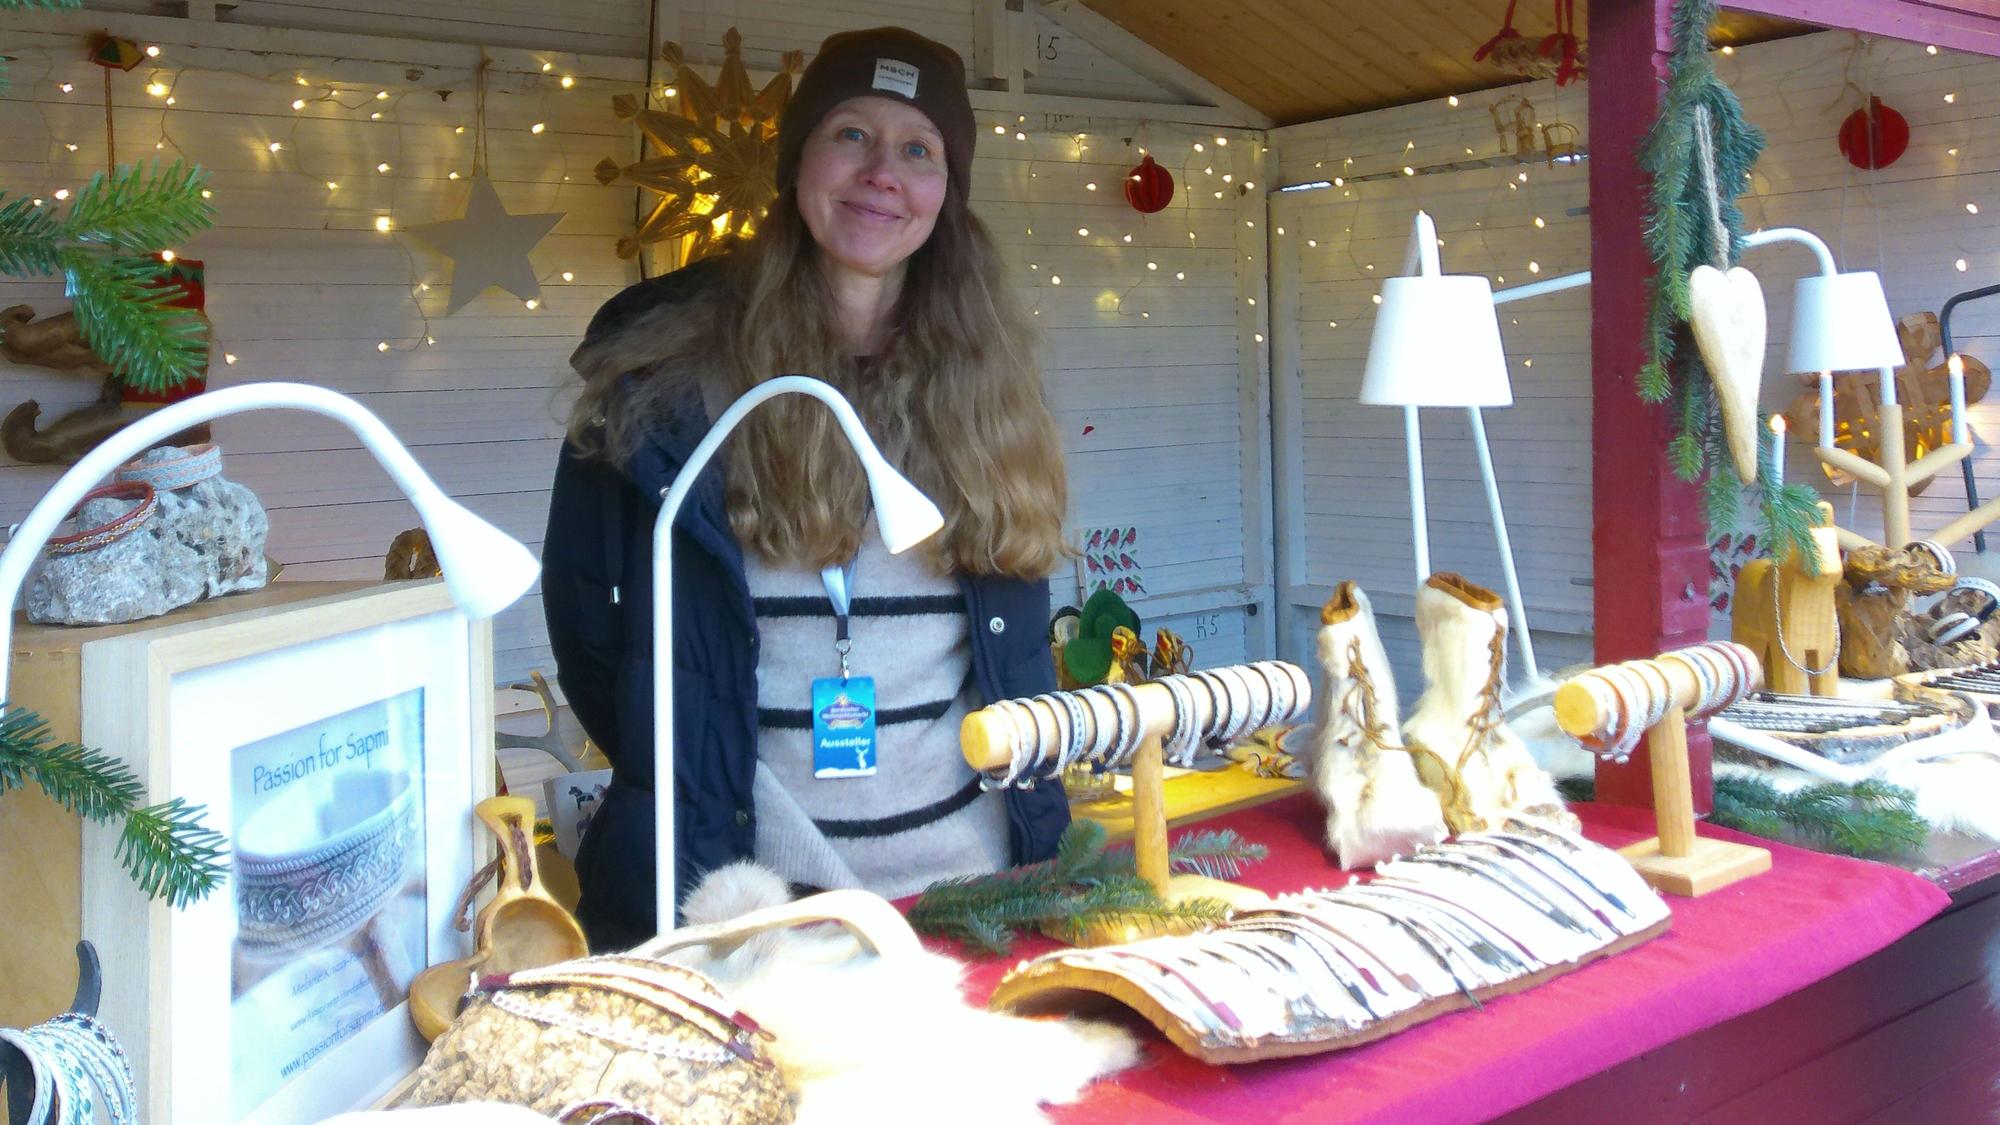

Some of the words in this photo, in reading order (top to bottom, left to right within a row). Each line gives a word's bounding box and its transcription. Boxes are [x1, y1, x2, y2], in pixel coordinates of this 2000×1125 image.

[253, 752, 316, 795] Passion
[319, 733, 342, 769] for
[345, 721, 389, 769] Sapmi
[820, 737, 871, 749] Aussteller
[280, 1000, 387, 1079] www.passionforsapmi.d
